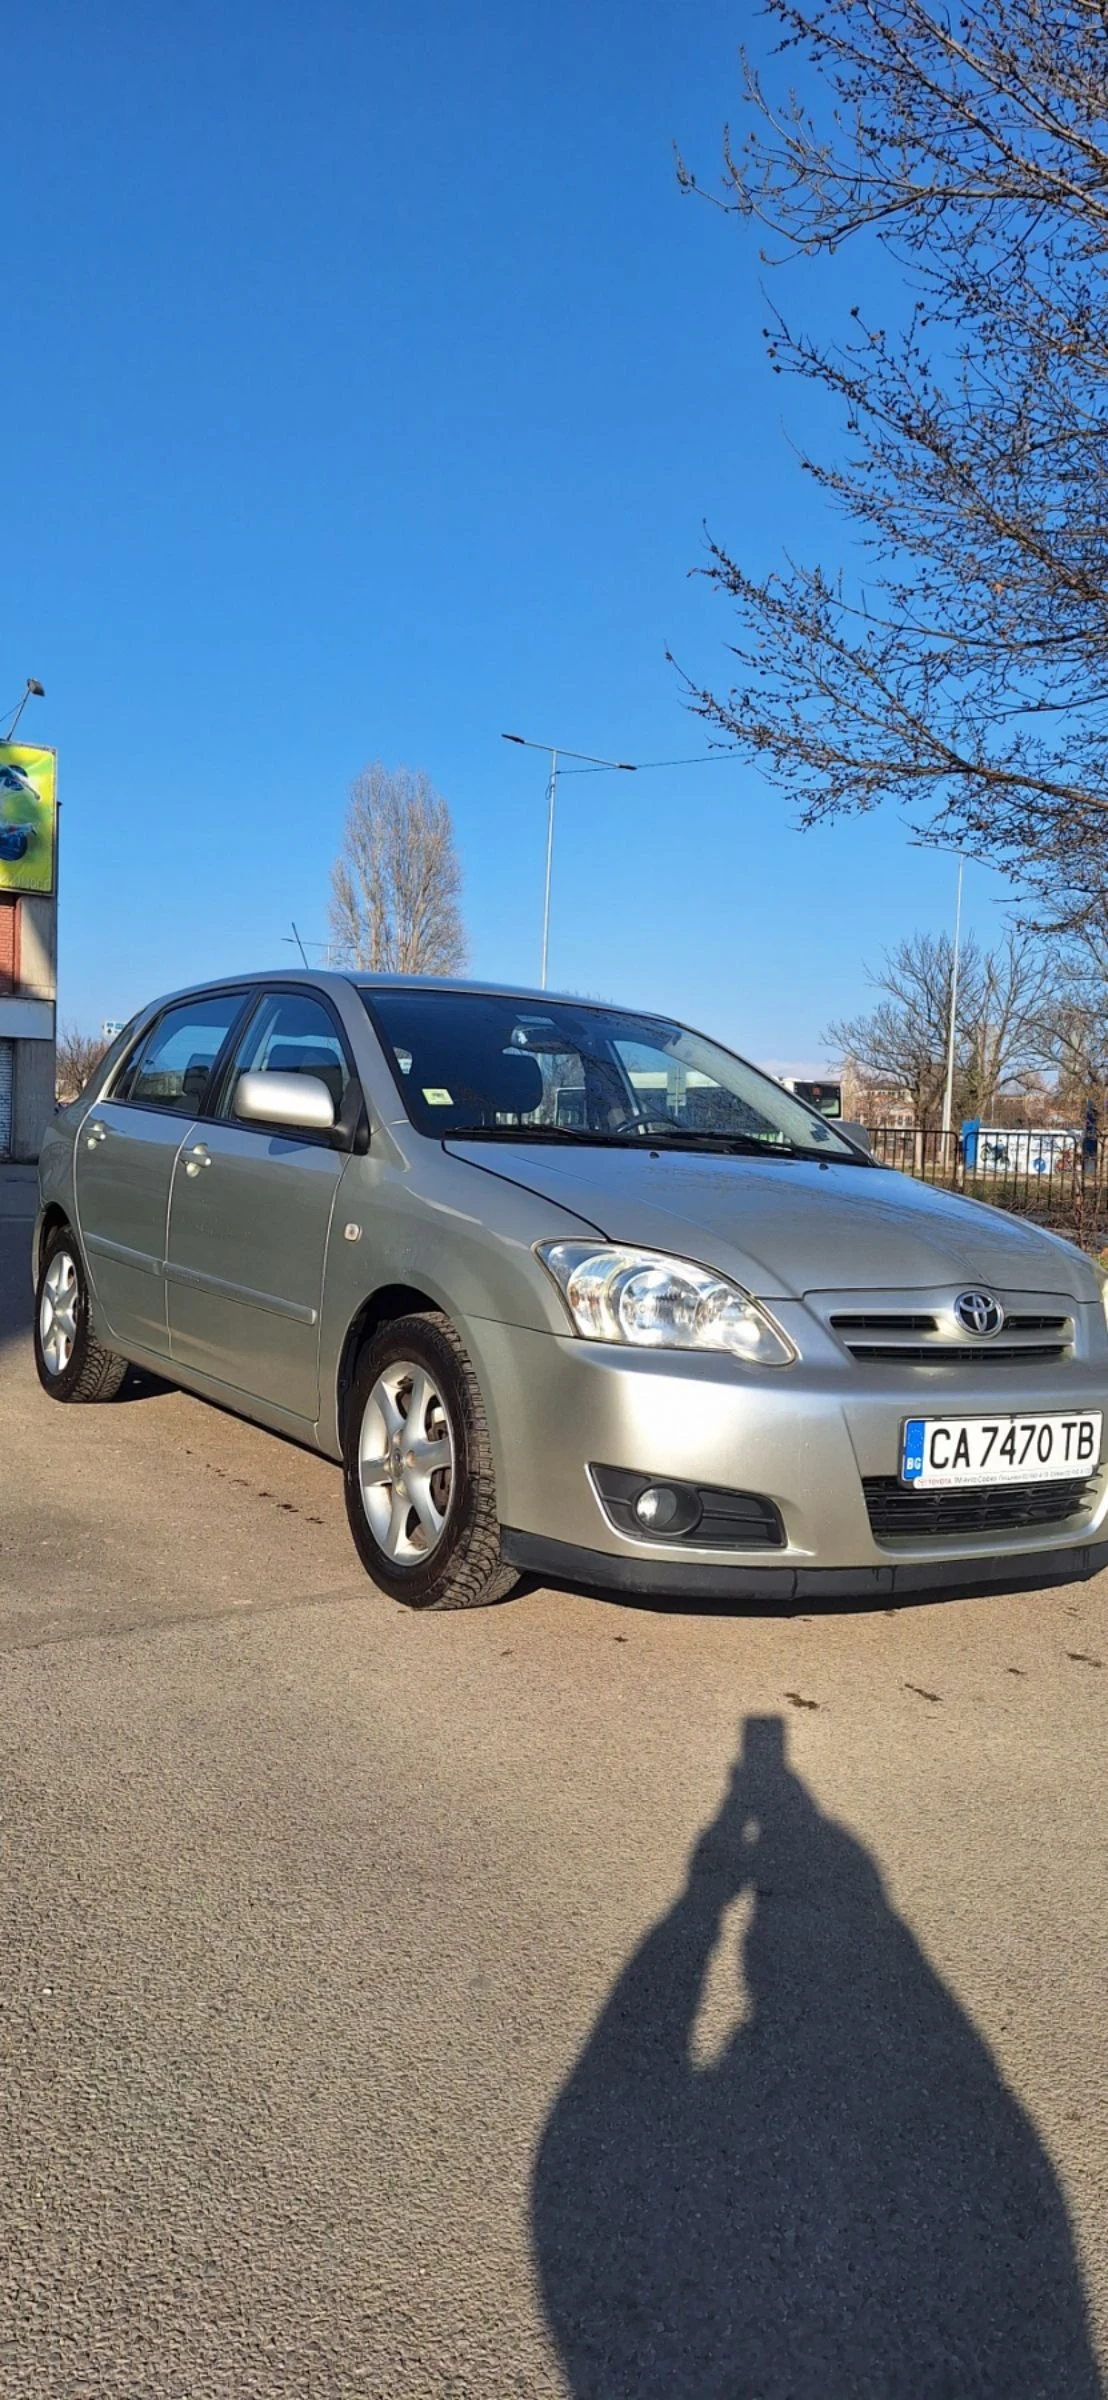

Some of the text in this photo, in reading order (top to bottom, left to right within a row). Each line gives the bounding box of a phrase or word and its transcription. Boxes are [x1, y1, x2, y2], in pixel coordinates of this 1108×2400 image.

[930, 1421, 1094, 1469] CA 7470 TB
[906, 1457, 922, 1470] BG
